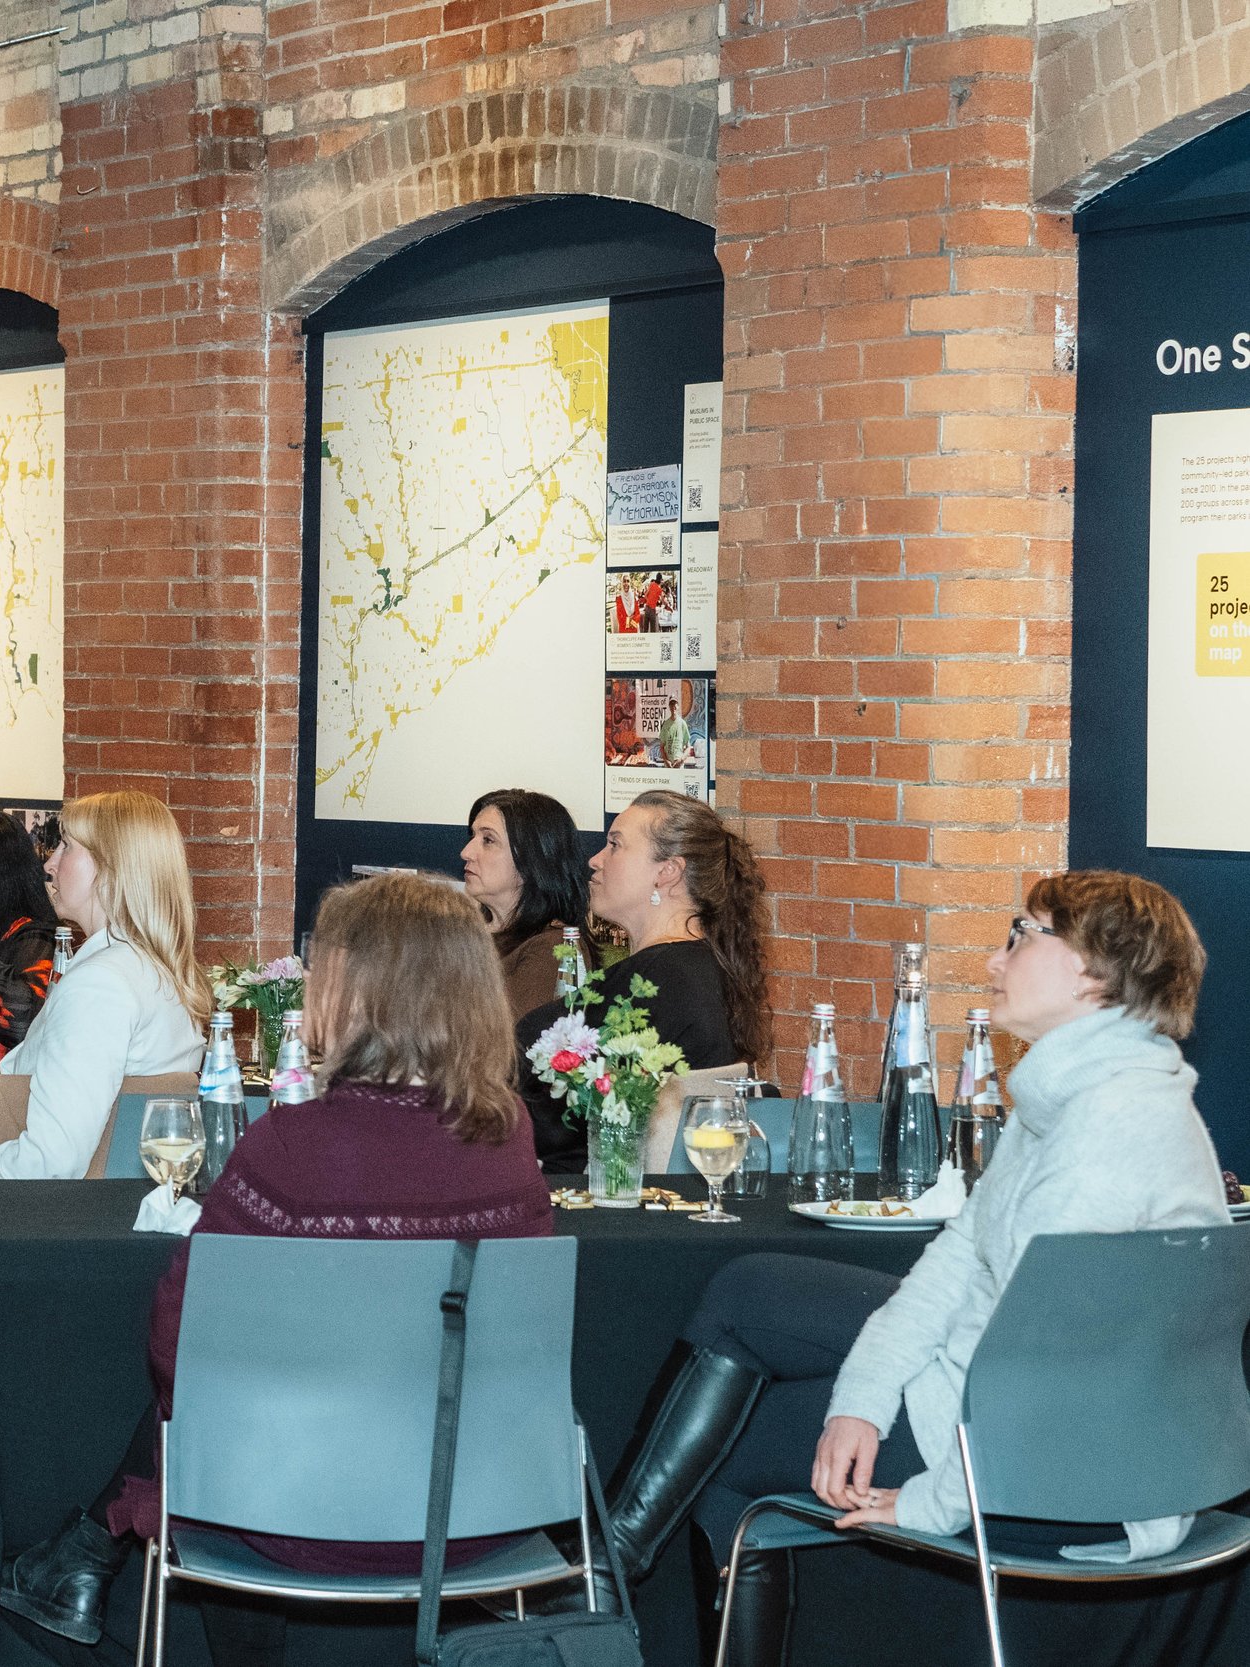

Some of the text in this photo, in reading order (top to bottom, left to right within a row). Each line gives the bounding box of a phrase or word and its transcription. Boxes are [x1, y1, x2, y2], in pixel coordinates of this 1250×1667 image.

[1156, 339, 1222, 375] One
[705, 416, 720, 424] SPACE
[1182, 457, 1195, 466] The
[1196, 455, 1206, 466] 25
[1206, 455, 1235, 466] projects
[647, 472, 657, 480] OF
[621, 480, 670, 494] CEDARBROOK
[1180, 485, 1199, 495] since
[632, 490, 678, 505] THOMSON
[1180, 499, 1195, 509] 200
[1195, 500, 1220, 510] groups
[1220, 498, 1244, 507] across
[619, 505, 664, 521] MEMORIAL
[1180, 513, 1209, 525] program
[1227, 511, 1247, 522] parks
[687, 556, 696, 564] THE
[687, 565, 714, 573] MEADOWAY
[1210, 575, 1229, 592] 25
[1210, 597, 1250, 619] proje
[1210, 624, 1229, 638] on
[1209, 646, 1242, 665] map
[641, 697, 667, 706] Friends of
[641, 706, 667, 720] REGENT
[618, 776, 670, 785] FRIENDS OF REGENT PARK
